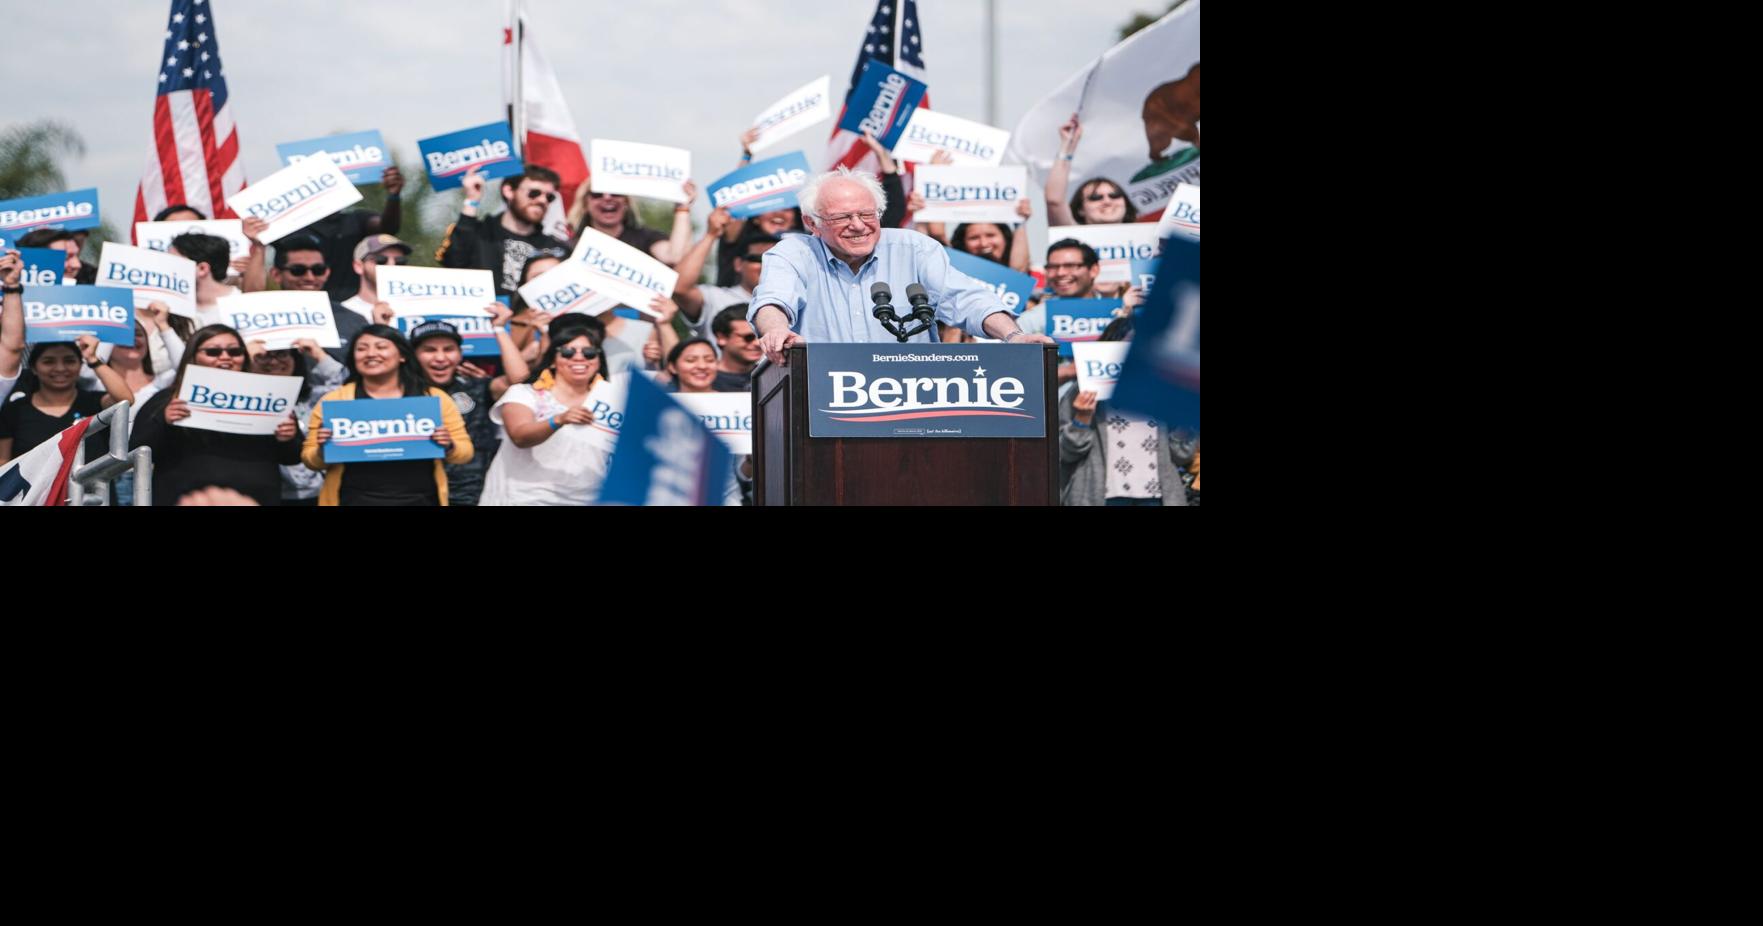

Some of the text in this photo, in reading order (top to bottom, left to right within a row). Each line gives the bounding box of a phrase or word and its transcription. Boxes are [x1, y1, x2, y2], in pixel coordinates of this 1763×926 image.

[858, 73, 906, 140] Bernie
[909, 124, 994, 158] Bernie
[426, 139, 509, 175] Bernie
[602, 156, 684, 180] Bernie
[248, 172, 337, 218] Bernie
[713, 168, 806, 206] Bernie
[924, 181, 1017, 201] Bernie
[0, 200, 93, 227] Bernie
[107, 261, 189, 294] Bernie
[581, 246, 665, 291] Bernie
[387, 280, 484, 297] Bernie
[24, 301, 128, 323] Bernie
[230, 307, 327, 330] Bernie
[872, 353, 979, 362] BernieSanders.com
[189, 384, 288, 412] Bernie
[828, 366, 1025, 408] Bernie
[330, 413, 436, 440] Bernie
